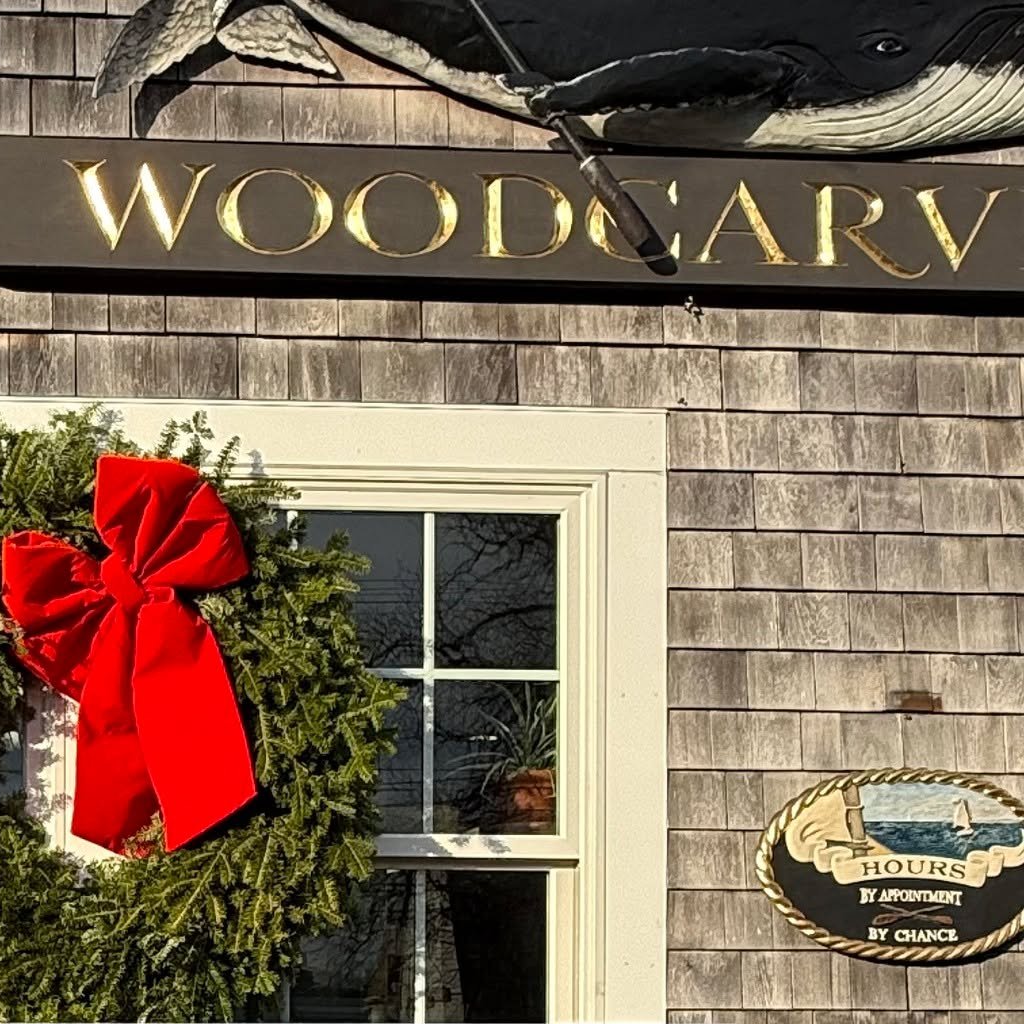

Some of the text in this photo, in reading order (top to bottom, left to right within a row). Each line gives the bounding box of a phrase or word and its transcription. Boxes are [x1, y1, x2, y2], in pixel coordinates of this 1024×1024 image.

[63, 159, 1024, 279] WOODCARV
[861, 859, 966, 880] HOURS
[859, 887, 963, 906] BY APPOINTMENT
[868, 926, 958, 942] BY CHANCE
